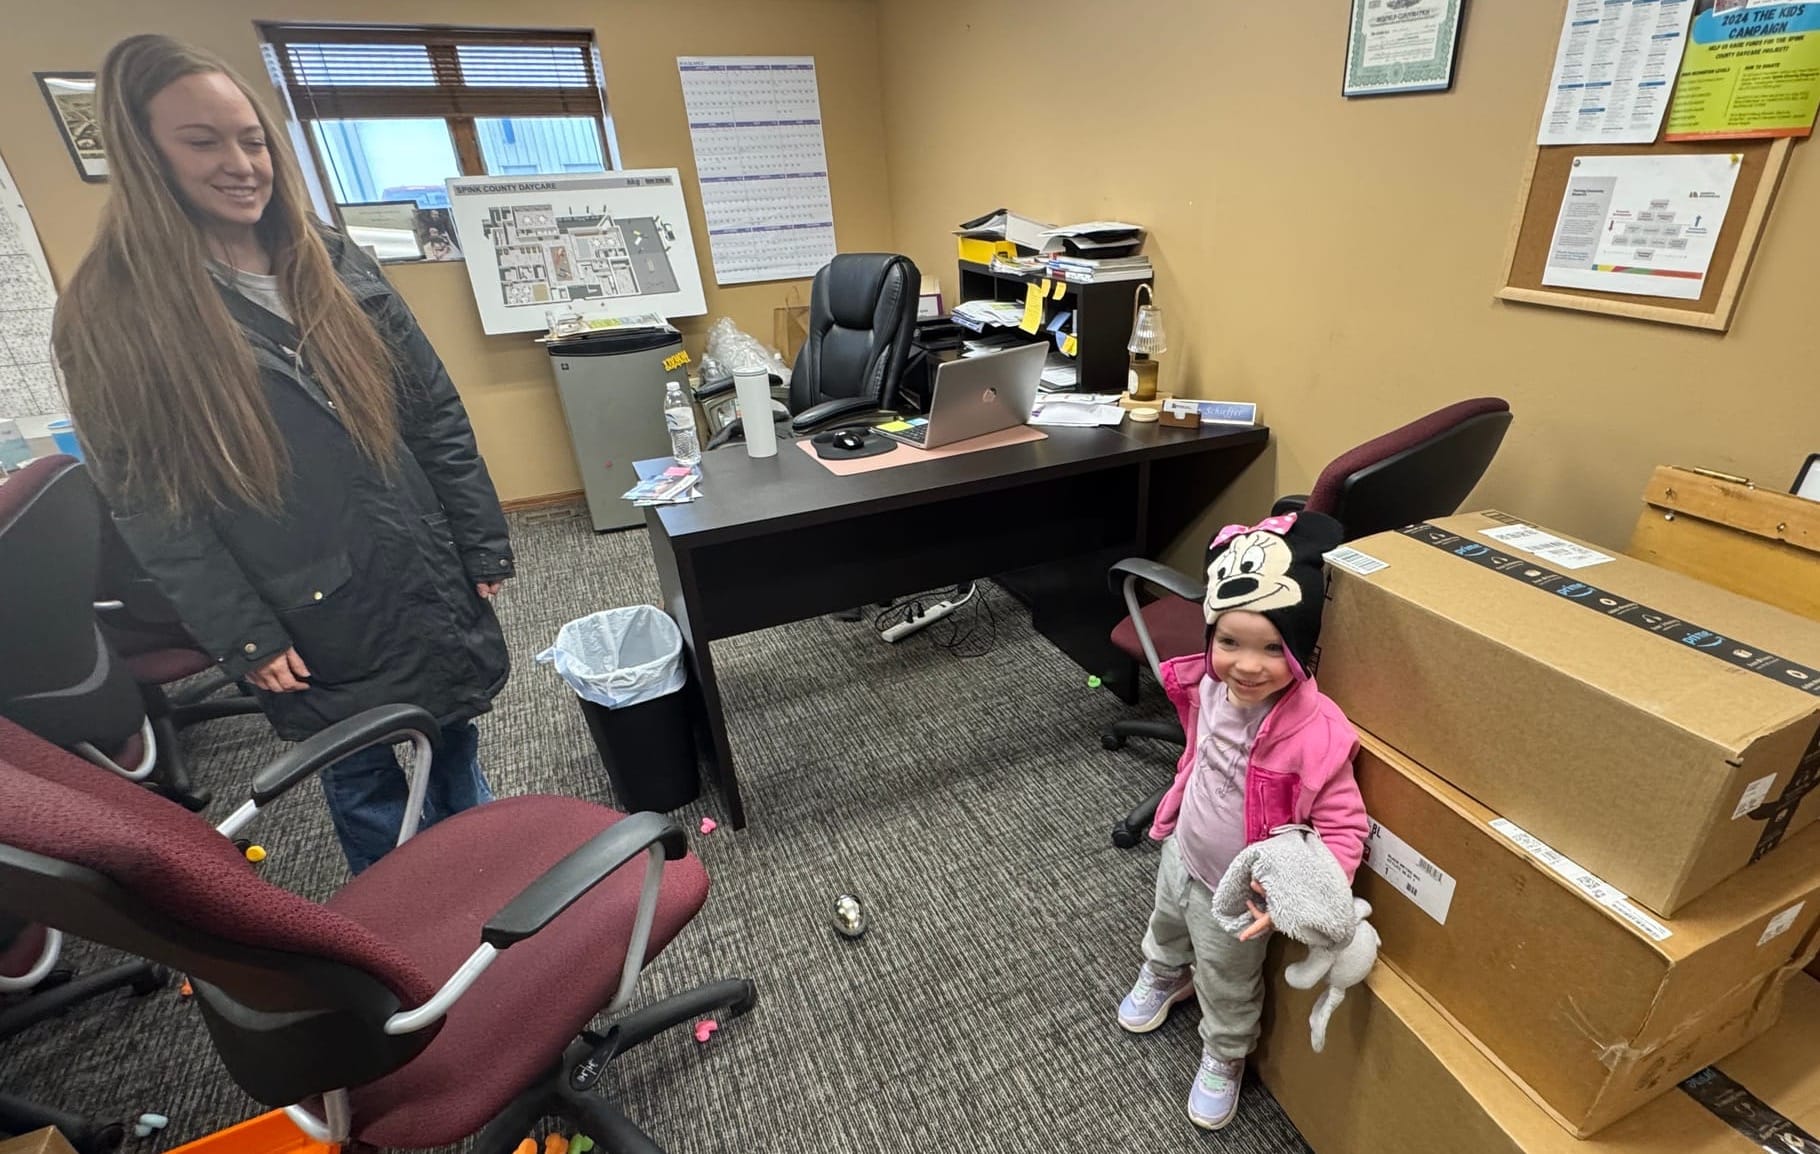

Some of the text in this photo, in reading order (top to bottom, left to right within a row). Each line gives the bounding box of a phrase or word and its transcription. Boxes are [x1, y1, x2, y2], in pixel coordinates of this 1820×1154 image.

[1722, 4, 1806, 27] 2024 THE KIDS
[1728, 21, 1789, 40] CAMPAIGN
[1746, 39, 1763, 47] FUNDS
[1715, 51, 1735, 59] COUNTY
[1736, 49, 1762, 58] DAYCARE
[456, 181, 557, 194] SPINK COUNTY DAYCARE
